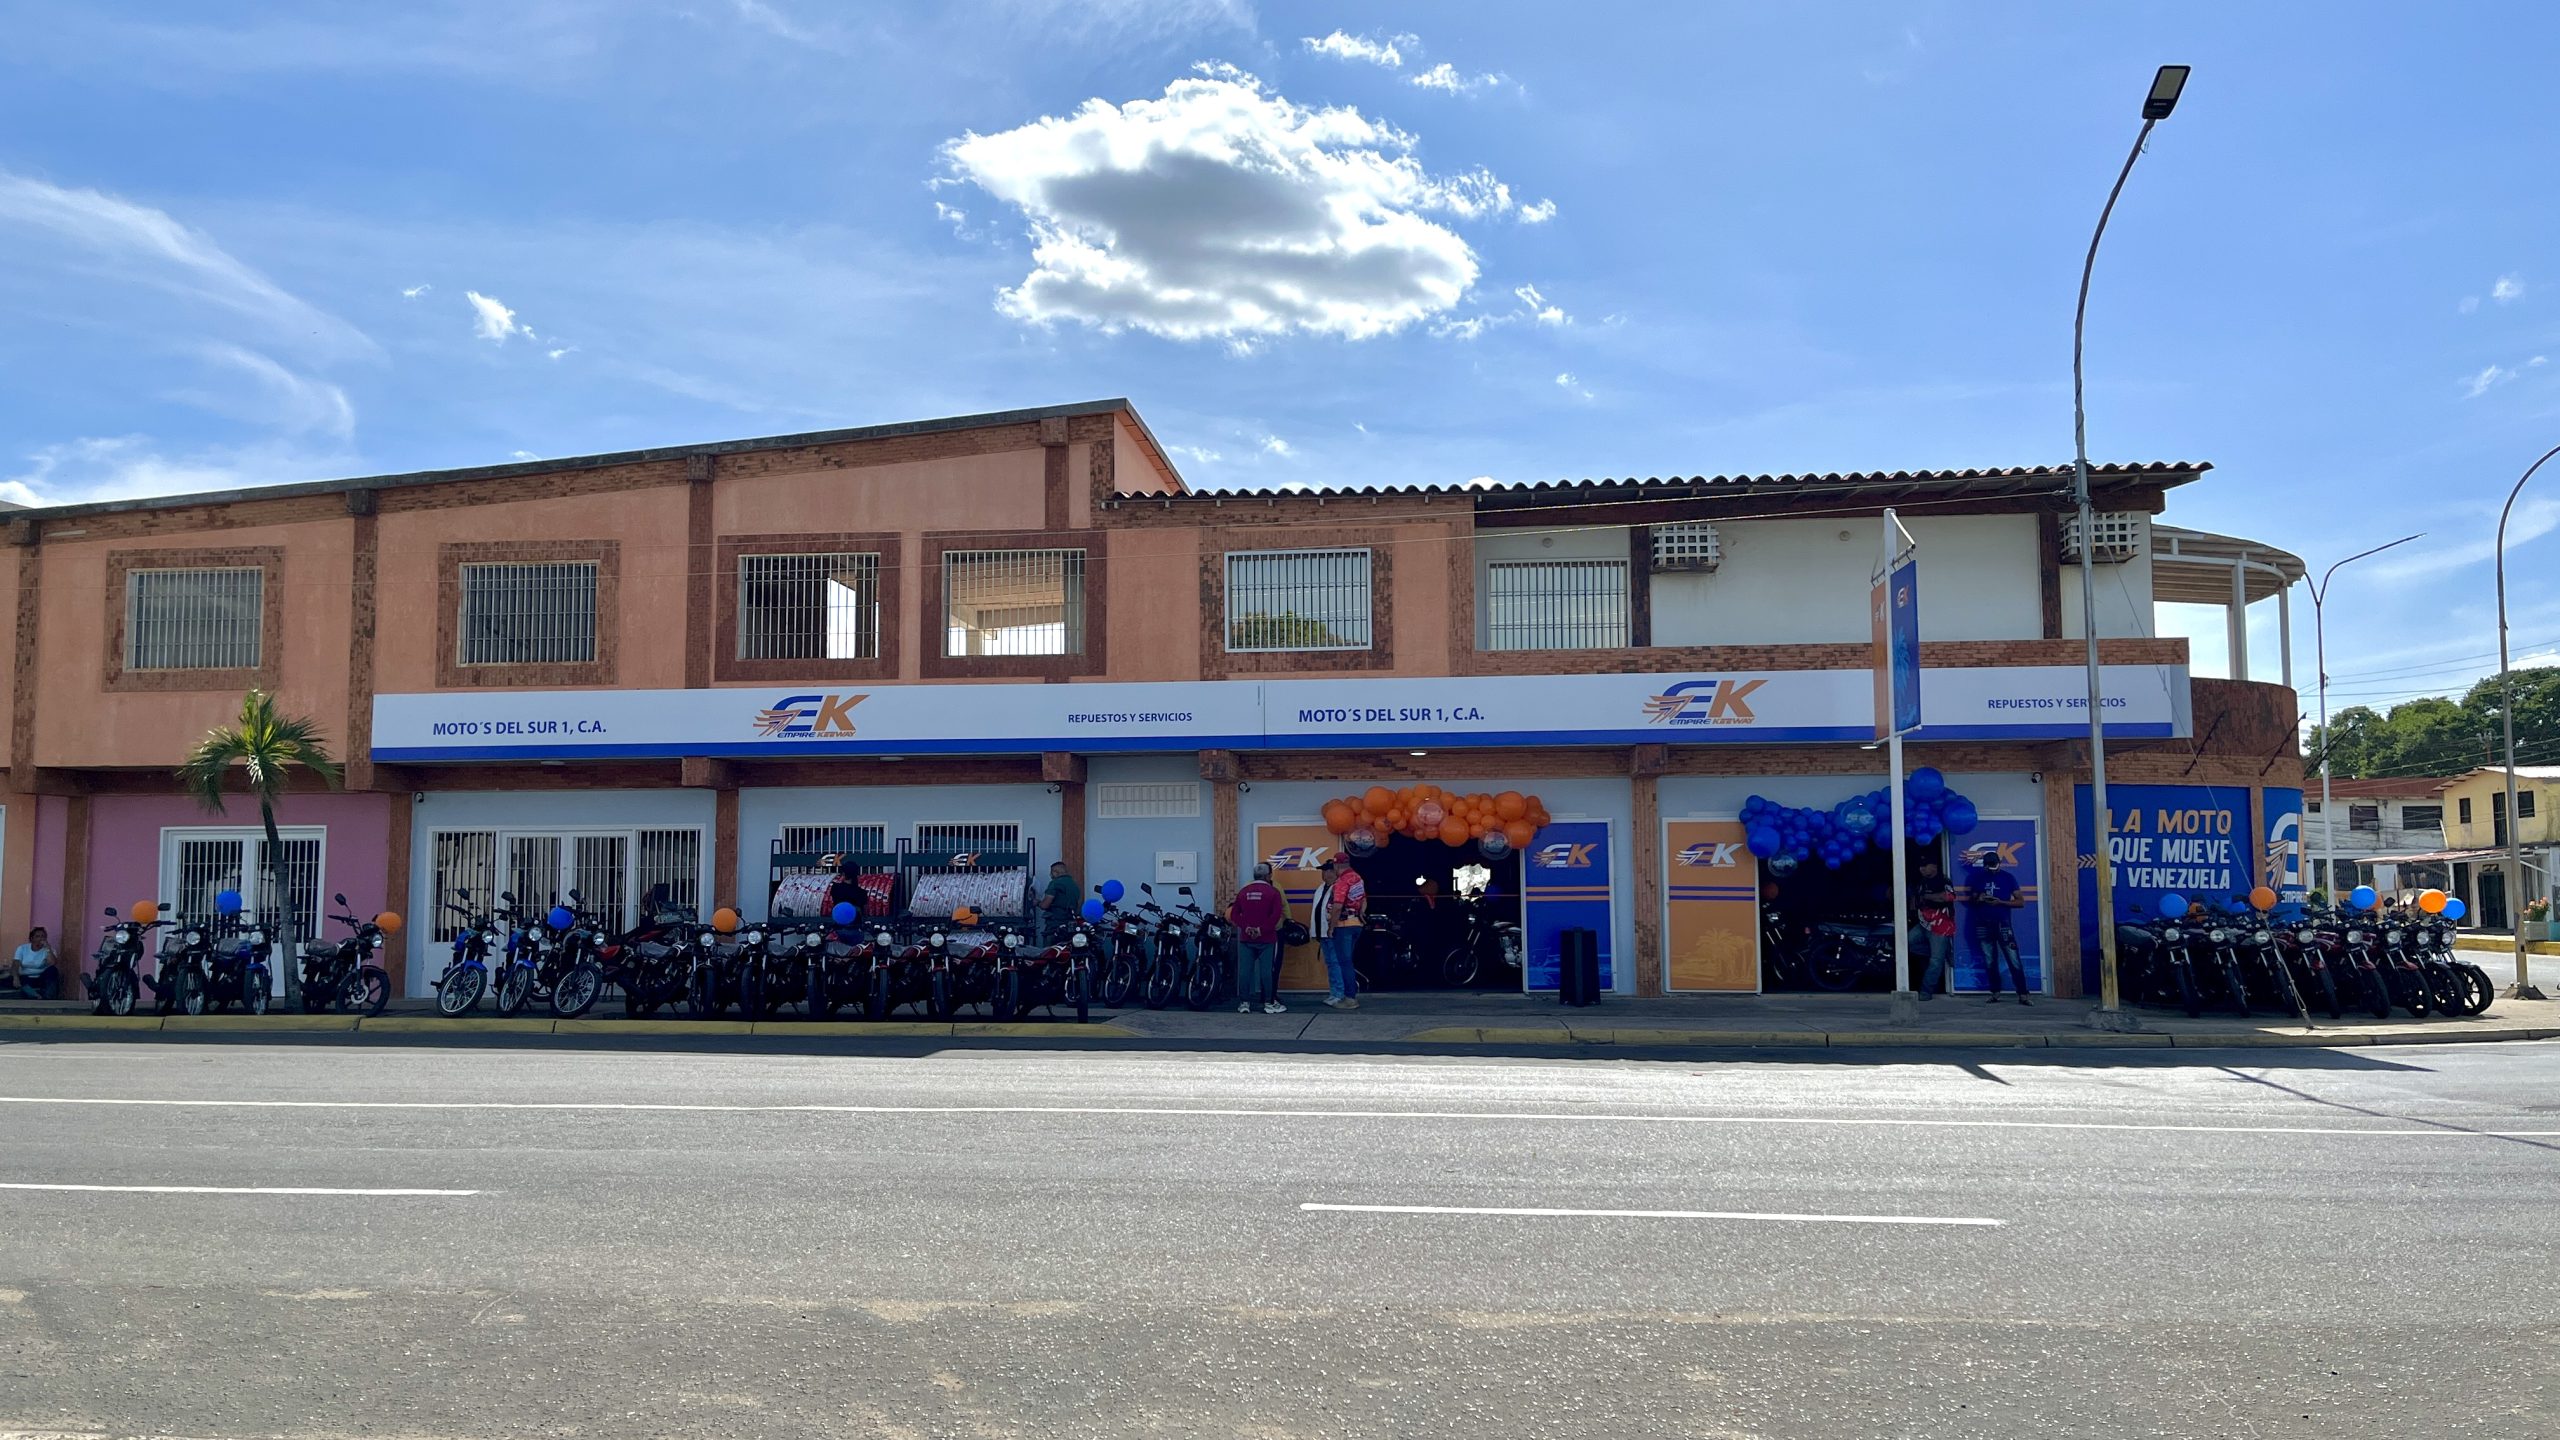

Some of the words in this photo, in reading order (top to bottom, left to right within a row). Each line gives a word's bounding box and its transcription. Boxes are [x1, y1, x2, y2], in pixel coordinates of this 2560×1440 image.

[1987, 698, 2054, 709] REPUESTOS
[2056, 698, 2064, 708] Y
[2066, 697, 2127, 708] SERCIOS
[1067, 713, 1128, 723] REPUESTOS
[1129, 713, 1136, 723] Y
[1138, 712, 1193, 722] SERVICIOS
[1365, 708, 1396, 722] DEL
[1399, 707, 1432, 722] SUR
[1435, 708, 1449, 723] 1,
[1453, 707, 1485, 721] C.A.
[495, 721, 524, 735] DEL
[527, 720, 558, 734] SUR
[561, 720, 574, 736] 1,
[577, 720, 607, 734] C.A.
[776, 731, 816, 739] EMPIRE
[2106, 808, 2141, 834] LA
[2157, 809, 2232, 835] MOTO
[2108, 837, 2153, 863] QUE
[2161, 838, 2231, 864] MUEVE
[2127, 867, 2231, 890] VENEZUELA
